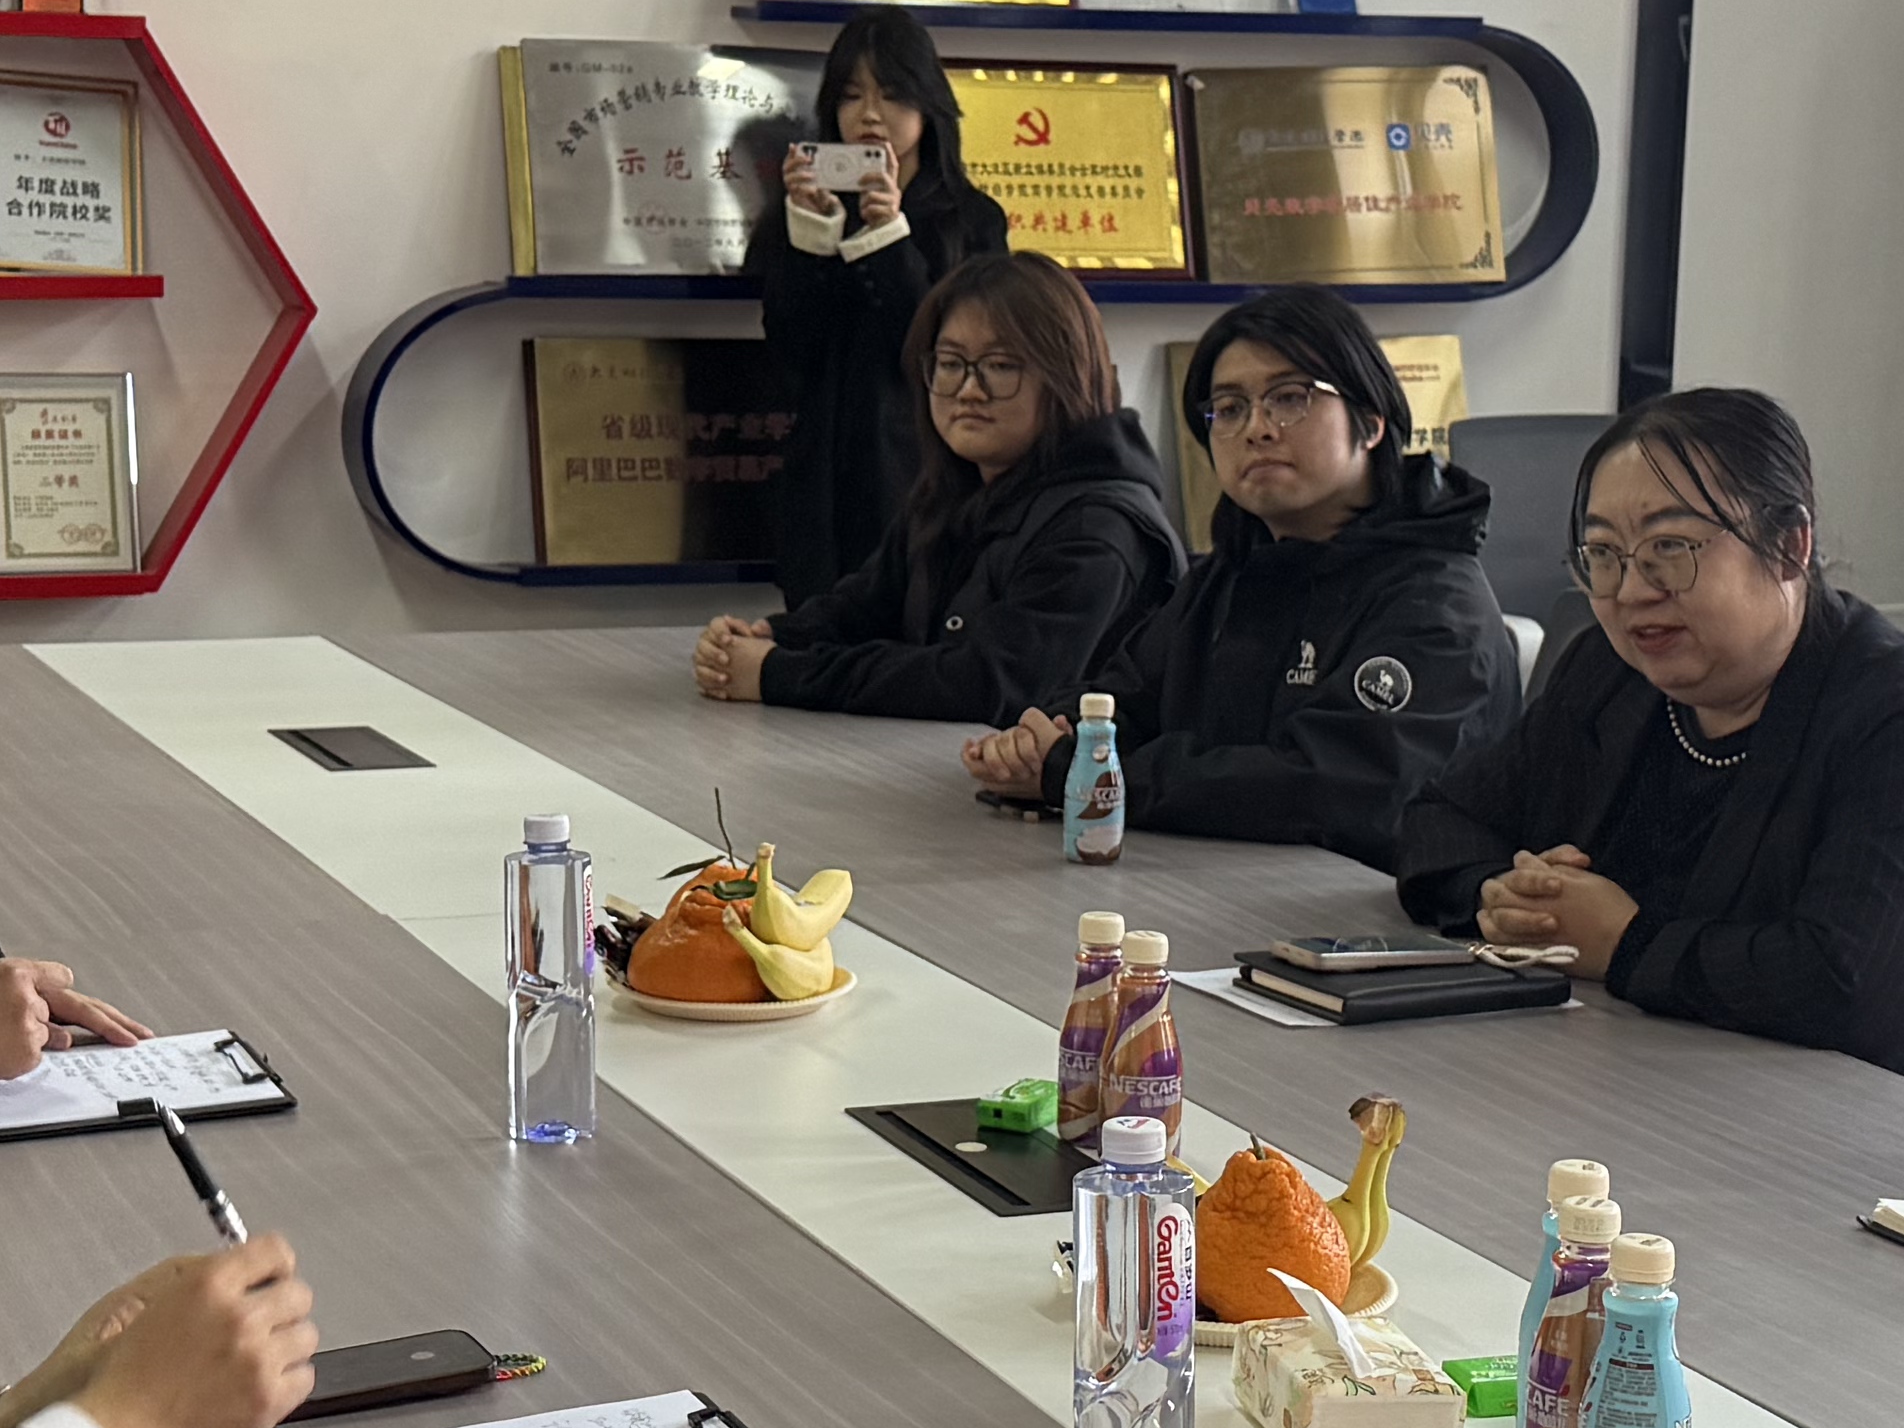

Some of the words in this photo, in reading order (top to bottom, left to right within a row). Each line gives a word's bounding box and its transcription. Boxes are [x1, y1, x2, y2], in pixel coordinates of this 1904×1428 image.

[16, 174, 101, 201] 年度战略
[5, 197, 113, 225] 合作院校奖
